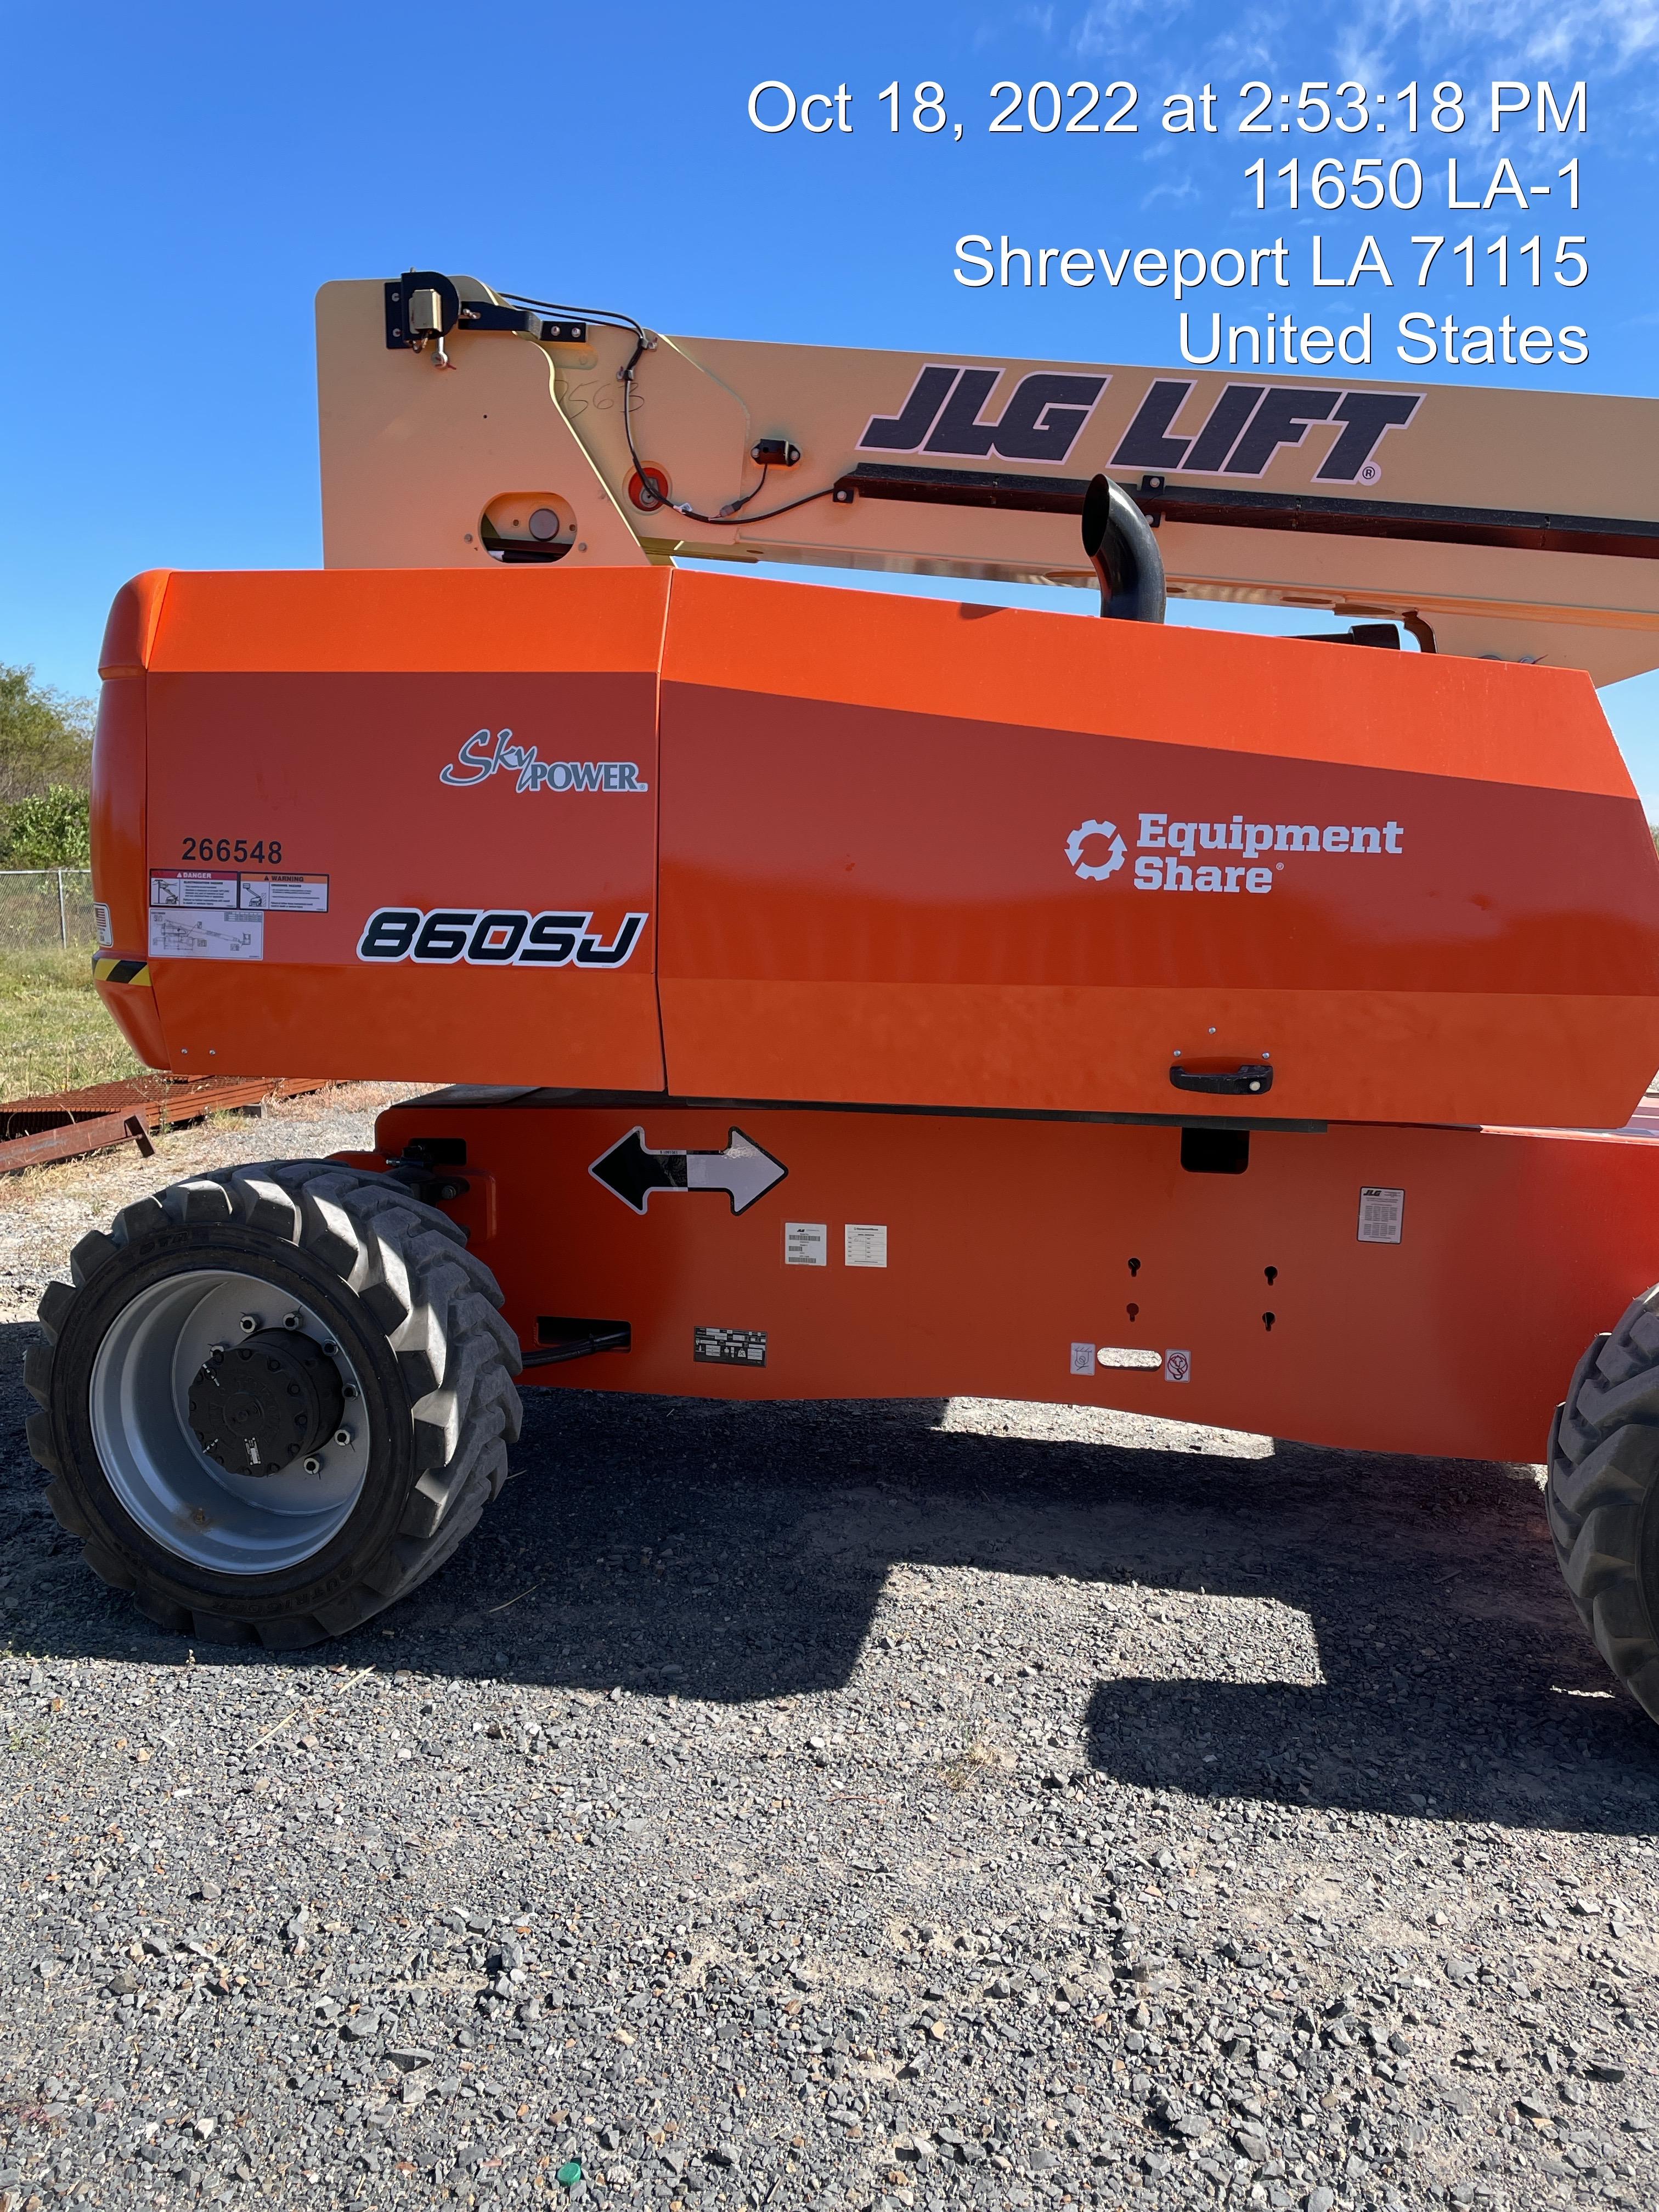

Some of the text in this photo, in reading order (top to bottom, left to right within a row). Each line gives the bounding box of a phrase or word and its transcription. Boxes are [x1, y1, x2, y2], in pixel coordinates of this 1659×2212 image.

[857, 365, 1425, 483] JLG LIFT
[181, 837, 283, 865] 266548
[1136, 812, 1404, 859] Equipment
[1133, 855, 1273, 894] Share
[358, 909, 647, 968] 860SJ
